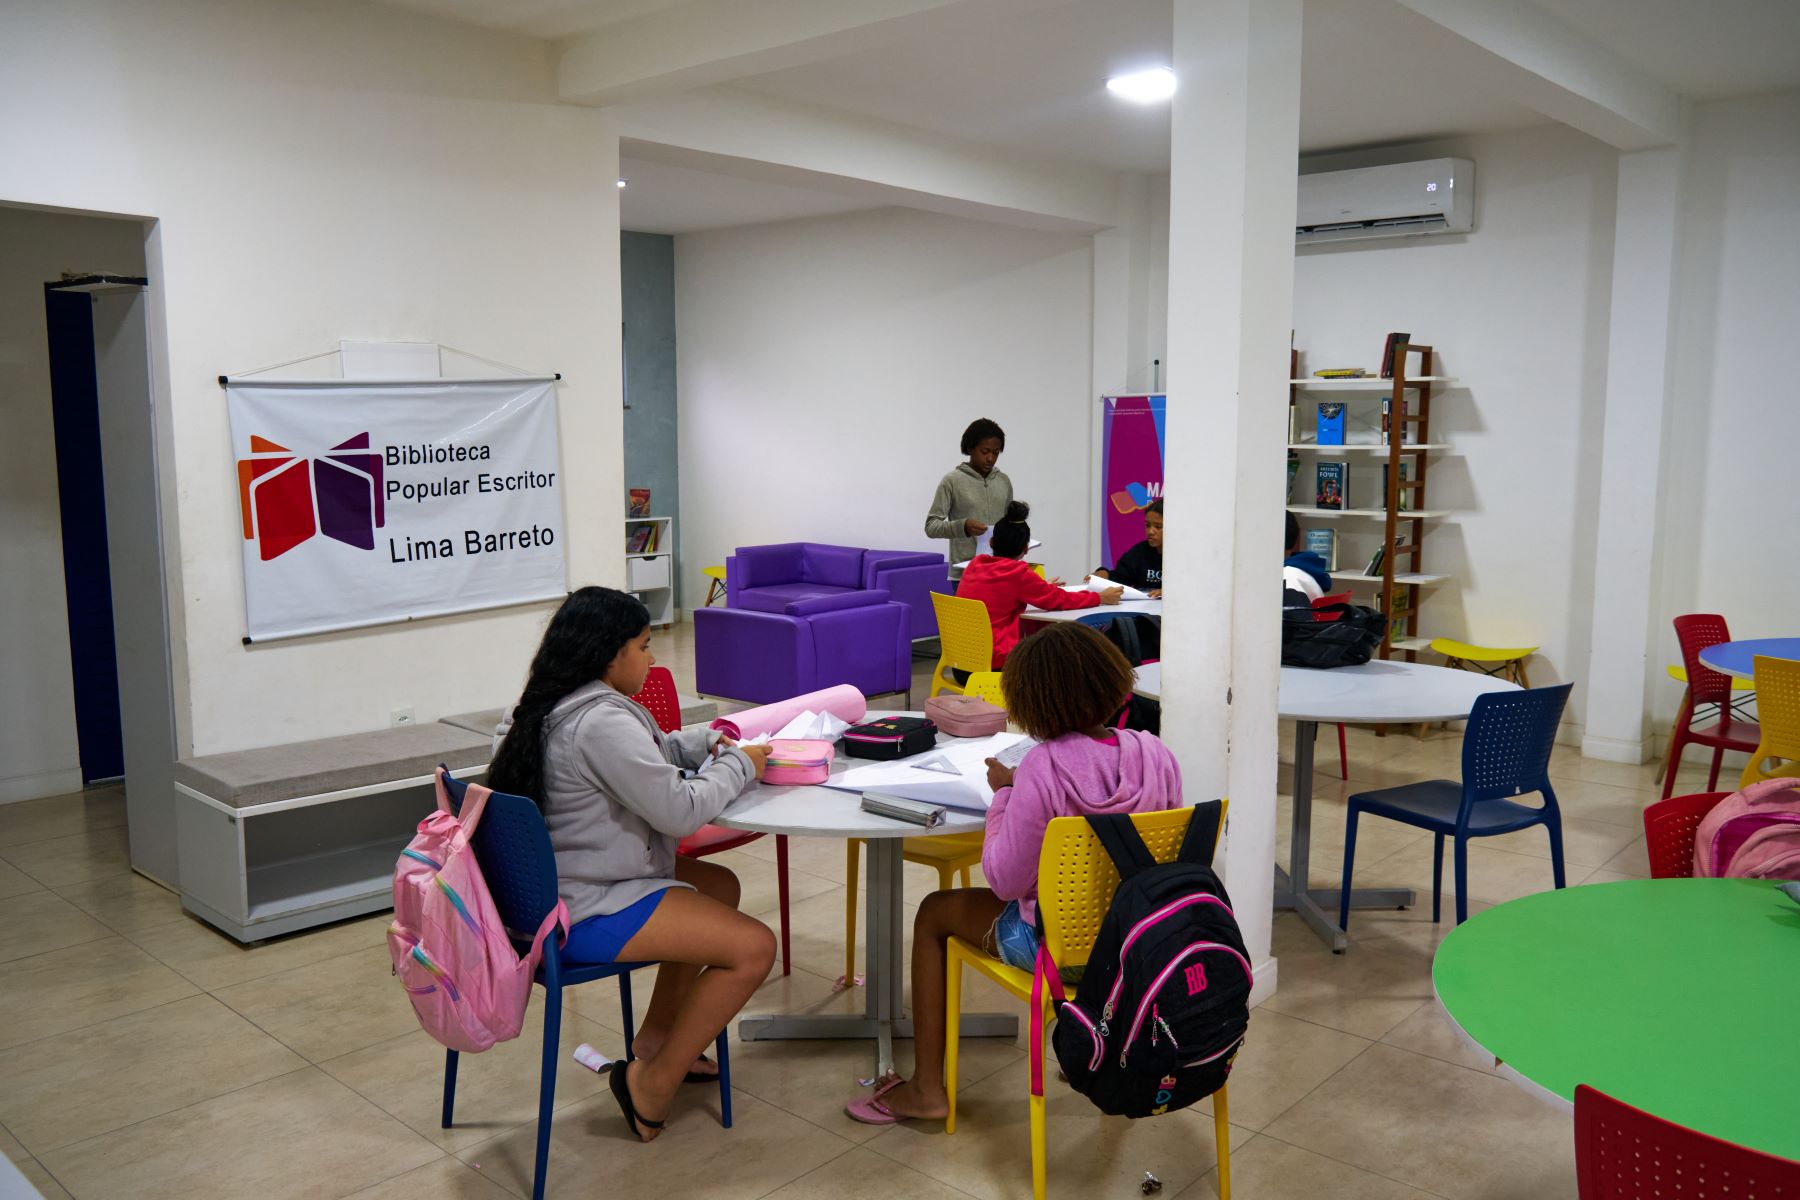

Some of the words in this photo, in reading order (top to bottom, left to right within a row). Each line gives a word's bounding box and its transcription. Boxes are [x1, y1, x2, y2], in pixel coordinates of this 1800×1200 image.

[1426, 183, 1437, 192] 20
[385, 443, 491, 466] Biblioteca
[386, 477, 470, 503] Popular
[478, 471, 556, 493] Escritor
[390, 537, 454, 563] Lima
[465, 525, 555, 555] Barreto
